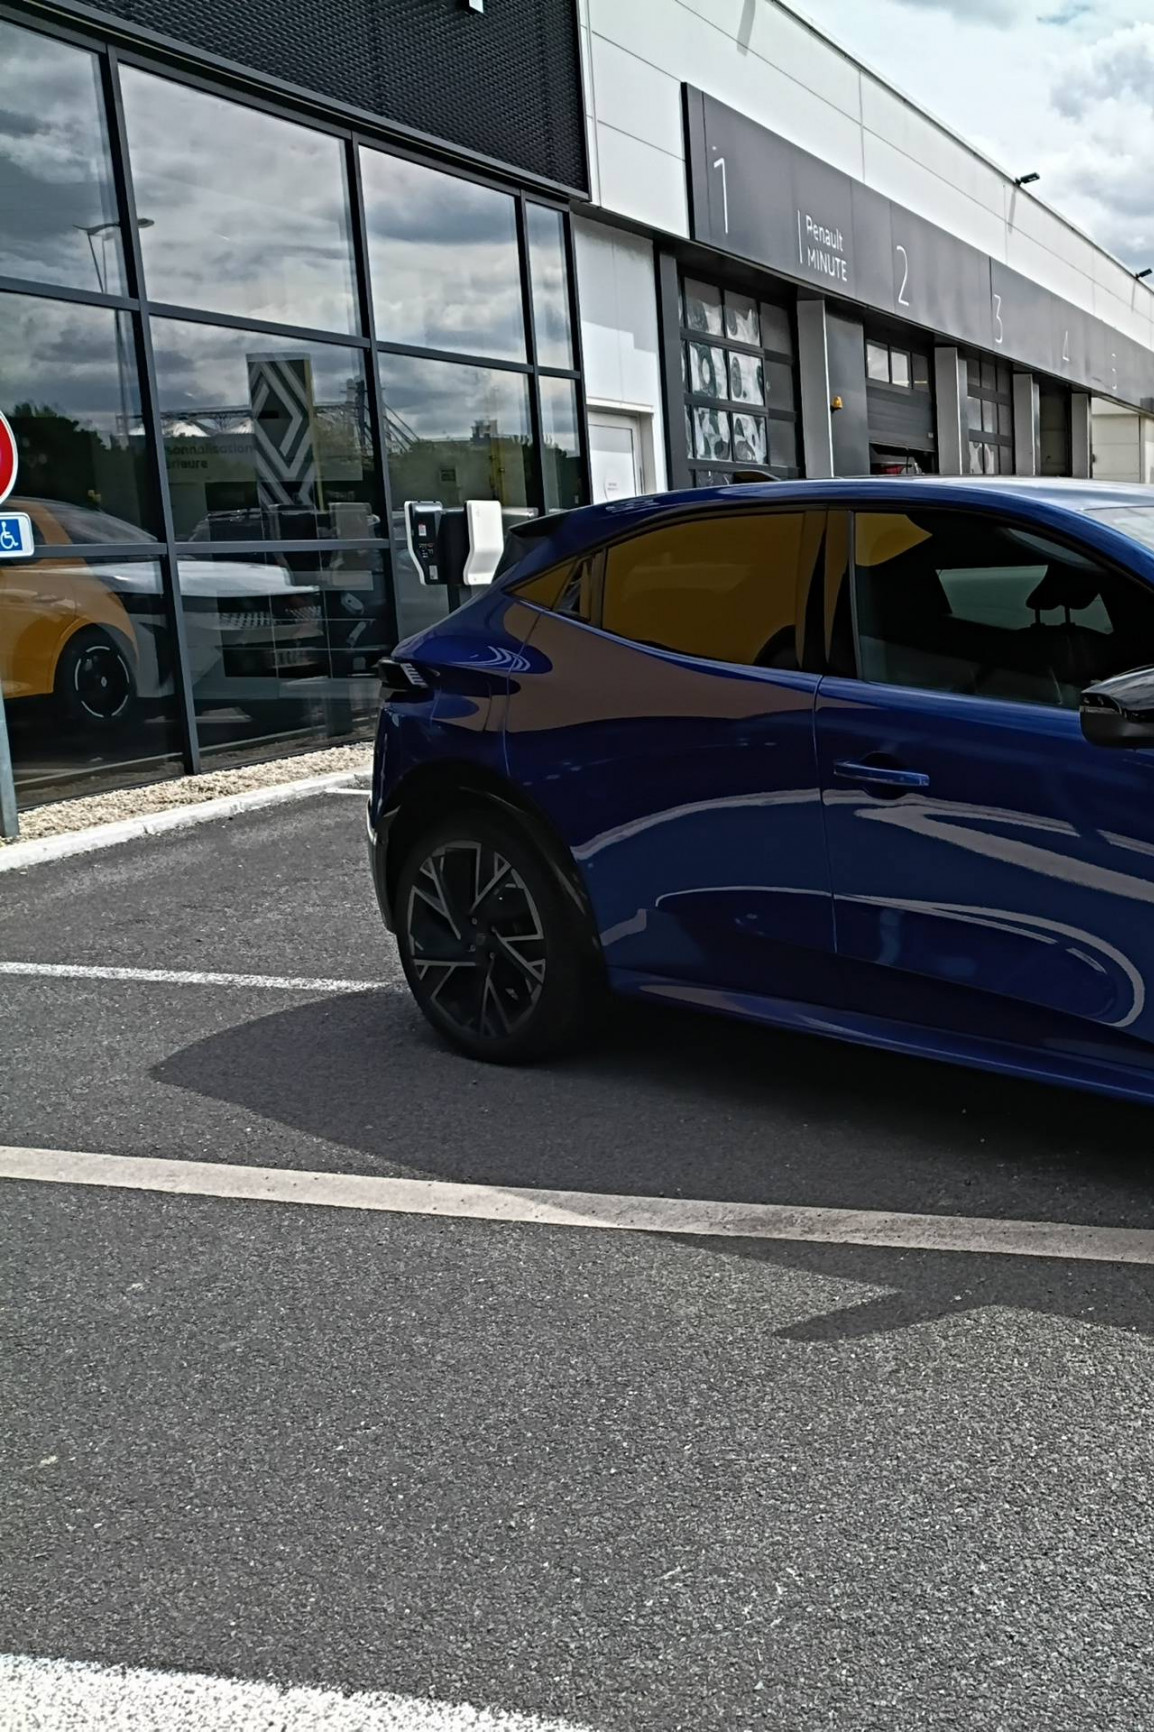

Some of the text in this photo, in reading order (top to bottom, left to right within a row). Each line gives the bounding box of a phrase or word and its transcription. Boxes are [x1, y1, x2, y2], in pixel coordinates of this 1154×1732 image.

[713, 157, 729, 235] 1
[805, 214, 844, 252] Renault
[807, 247, 848, 283] MINUTE
[896, 245, 910, 306] 2
[994, 293, 1004, 344] 3
